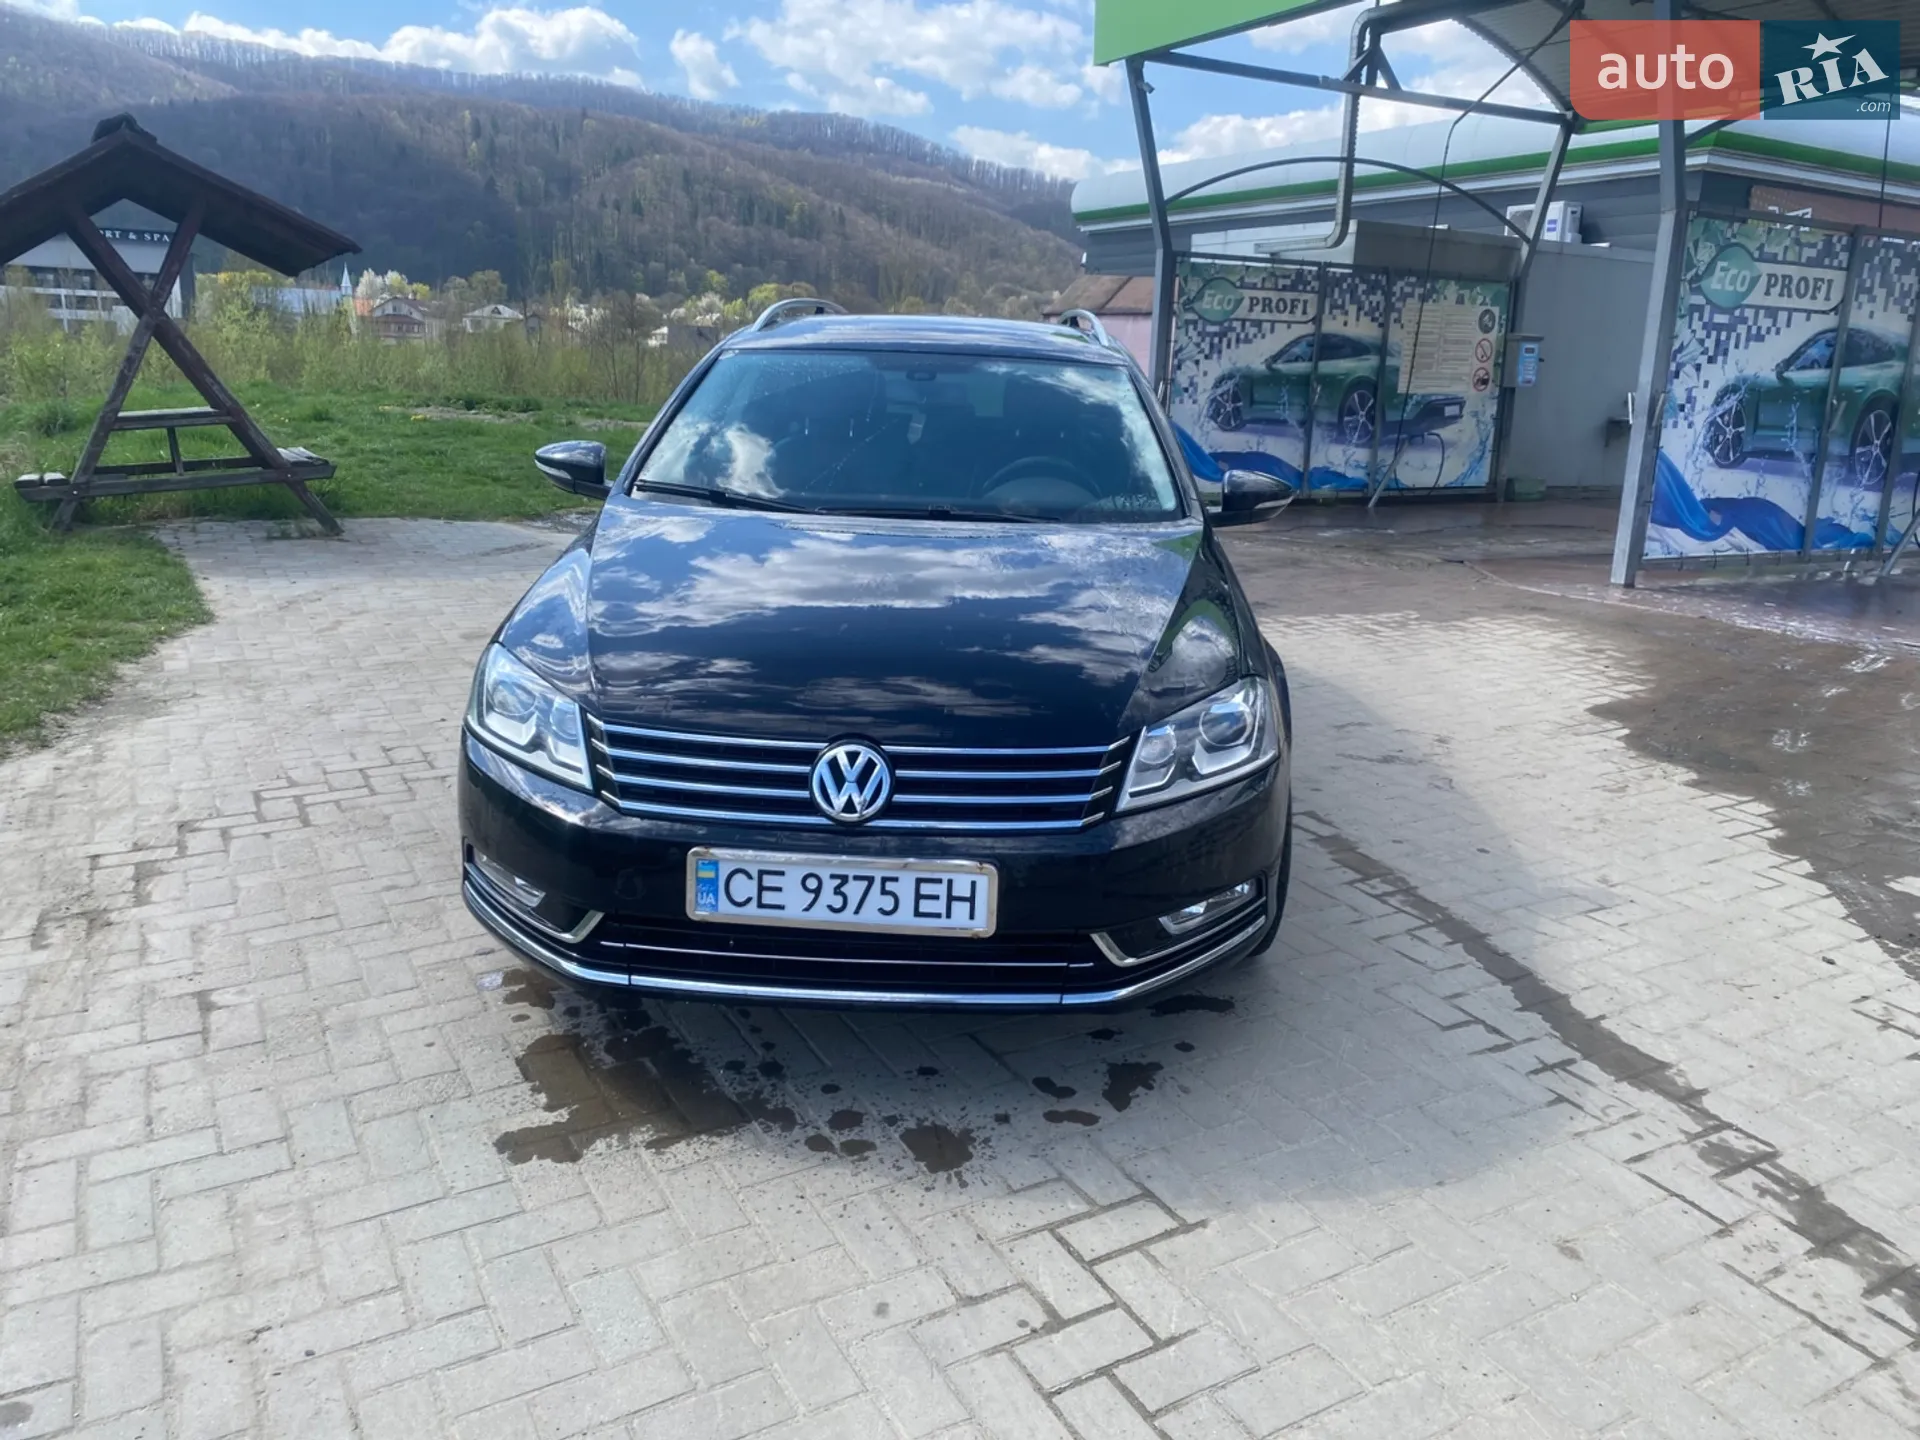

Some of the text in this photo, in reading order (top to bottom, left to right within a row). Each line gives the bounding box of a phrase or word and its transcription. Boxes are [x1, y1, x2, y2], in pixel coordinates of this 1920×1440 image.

[128, 231, 137, 240] &
[144, 232, 170, 242] SPA
[1763, 273, 1835, 302] PROFI
[1247, 296, 1309, 315] PROFI
[813, 744, 891, 822] VW
[697, 892, 716, 905] UA
[723, 867, 977, 921] CE 9375 EH
